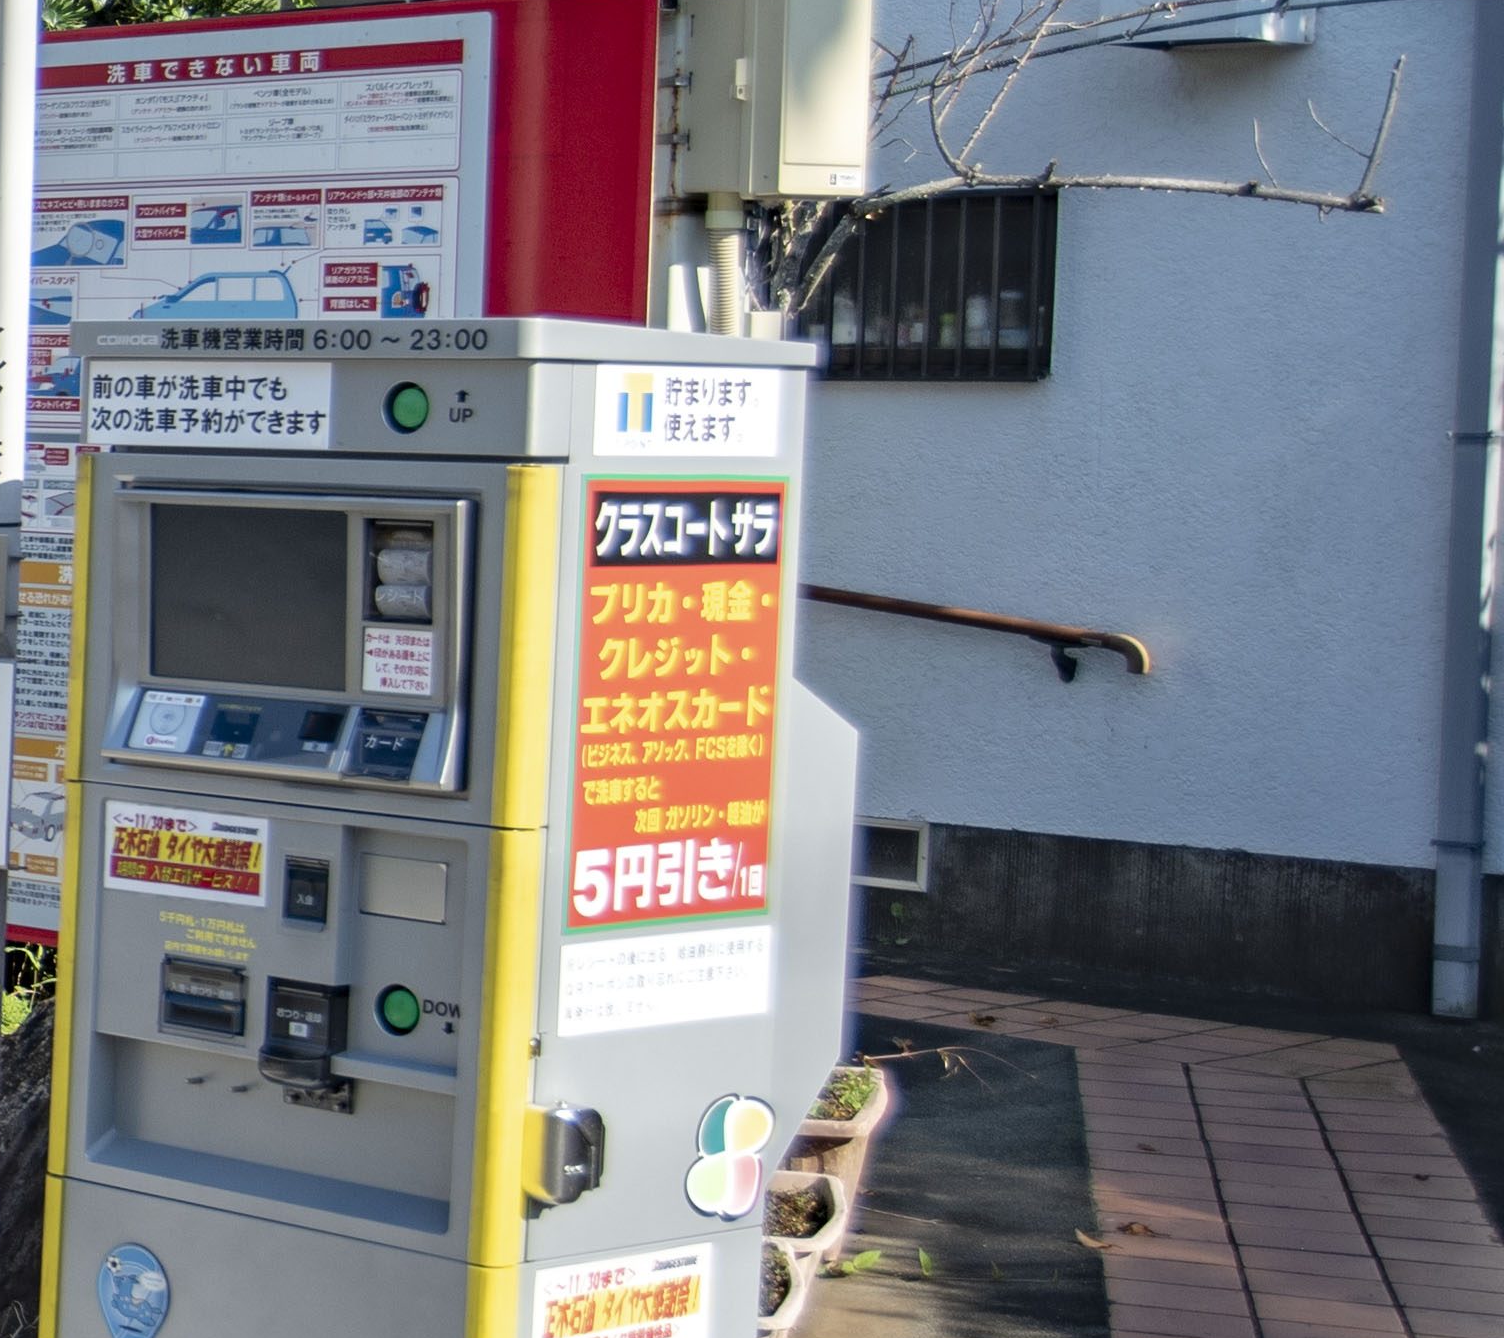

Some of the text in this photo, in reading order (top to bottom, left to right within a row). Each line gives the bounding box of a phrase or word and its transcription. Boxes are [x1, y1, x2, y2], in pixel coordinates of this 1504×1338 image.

[107, 52, 321, 84] 洗車できない車両
[160, 328, 304, 351] 洗車機営業時間
[314, 329, 371, 350] 6:00
[410, 328, 488, 350] 23:00
[92, 375, 287, 401] 前の車が洗車中でも
[91, 407, 327, 434] 次の洗車予約ができます
[449, 408, 472, 423] UP
[375, 590, 423, 605] レシート
[590, 580, 774, 624] プリカ・現金・
[365, 634, 389, 645] カードは
[599, 634, 752, 680] クレジット・
[380, 677, 428, 691] 挿入して下さい
[580, 685, 769, 734] エネオスカード
[365, 734, 404, 750] カード
[583, 776, 662, 804] で洗車すると
[634, 800, 767, 833] 次回 ガソリン・軽油が
